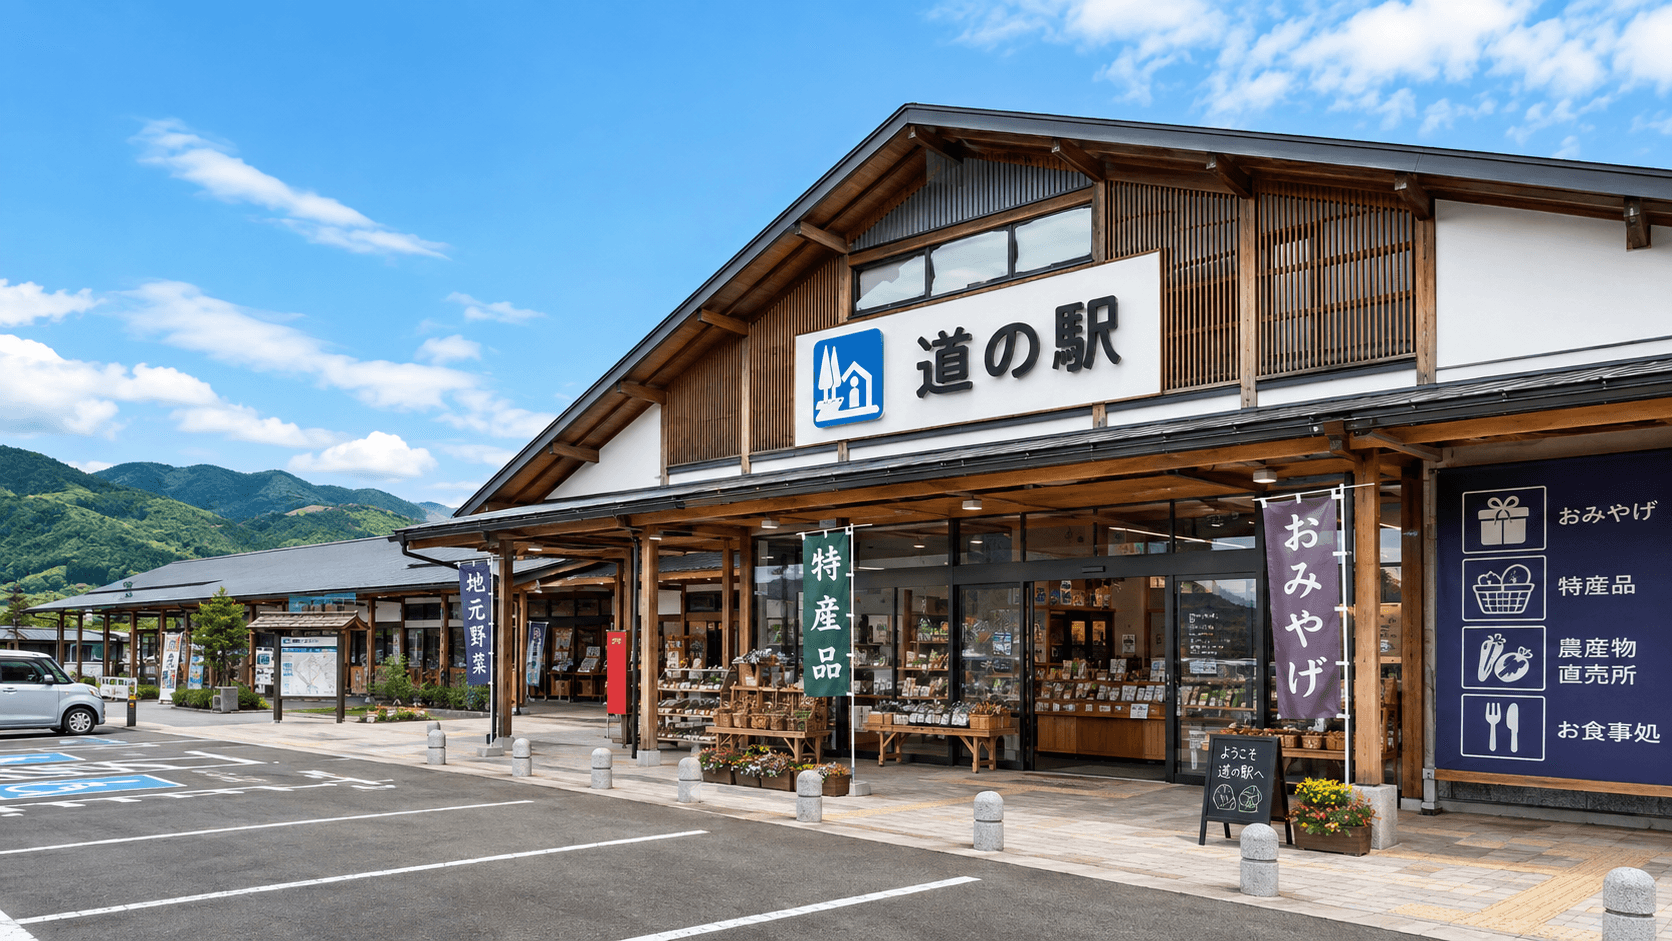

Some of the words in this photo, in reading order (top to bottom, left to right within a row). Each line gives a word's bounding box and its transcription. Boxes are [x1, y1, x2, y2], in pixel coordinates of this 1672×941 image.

[916, 295, 1122, 399] 道の駅
[1558, 500, 1658, 526] おみやげ
[1558, 575, 1636, 596] 特産品
[811, 545, 842, 680] 特産品
[1284, 513, 1328, 698] おみやげ
[466, 571, 487, 675] 地元野菜
[1558, 637, 1637, 658] 農産物
[1558, 664, 1637, 685] 直売所
[1558, 720, 1661, 743] お食事処
[1220, 745, 1257, 761] ようこそ
[1217, 763, 1265, 780] 道の駅へ
